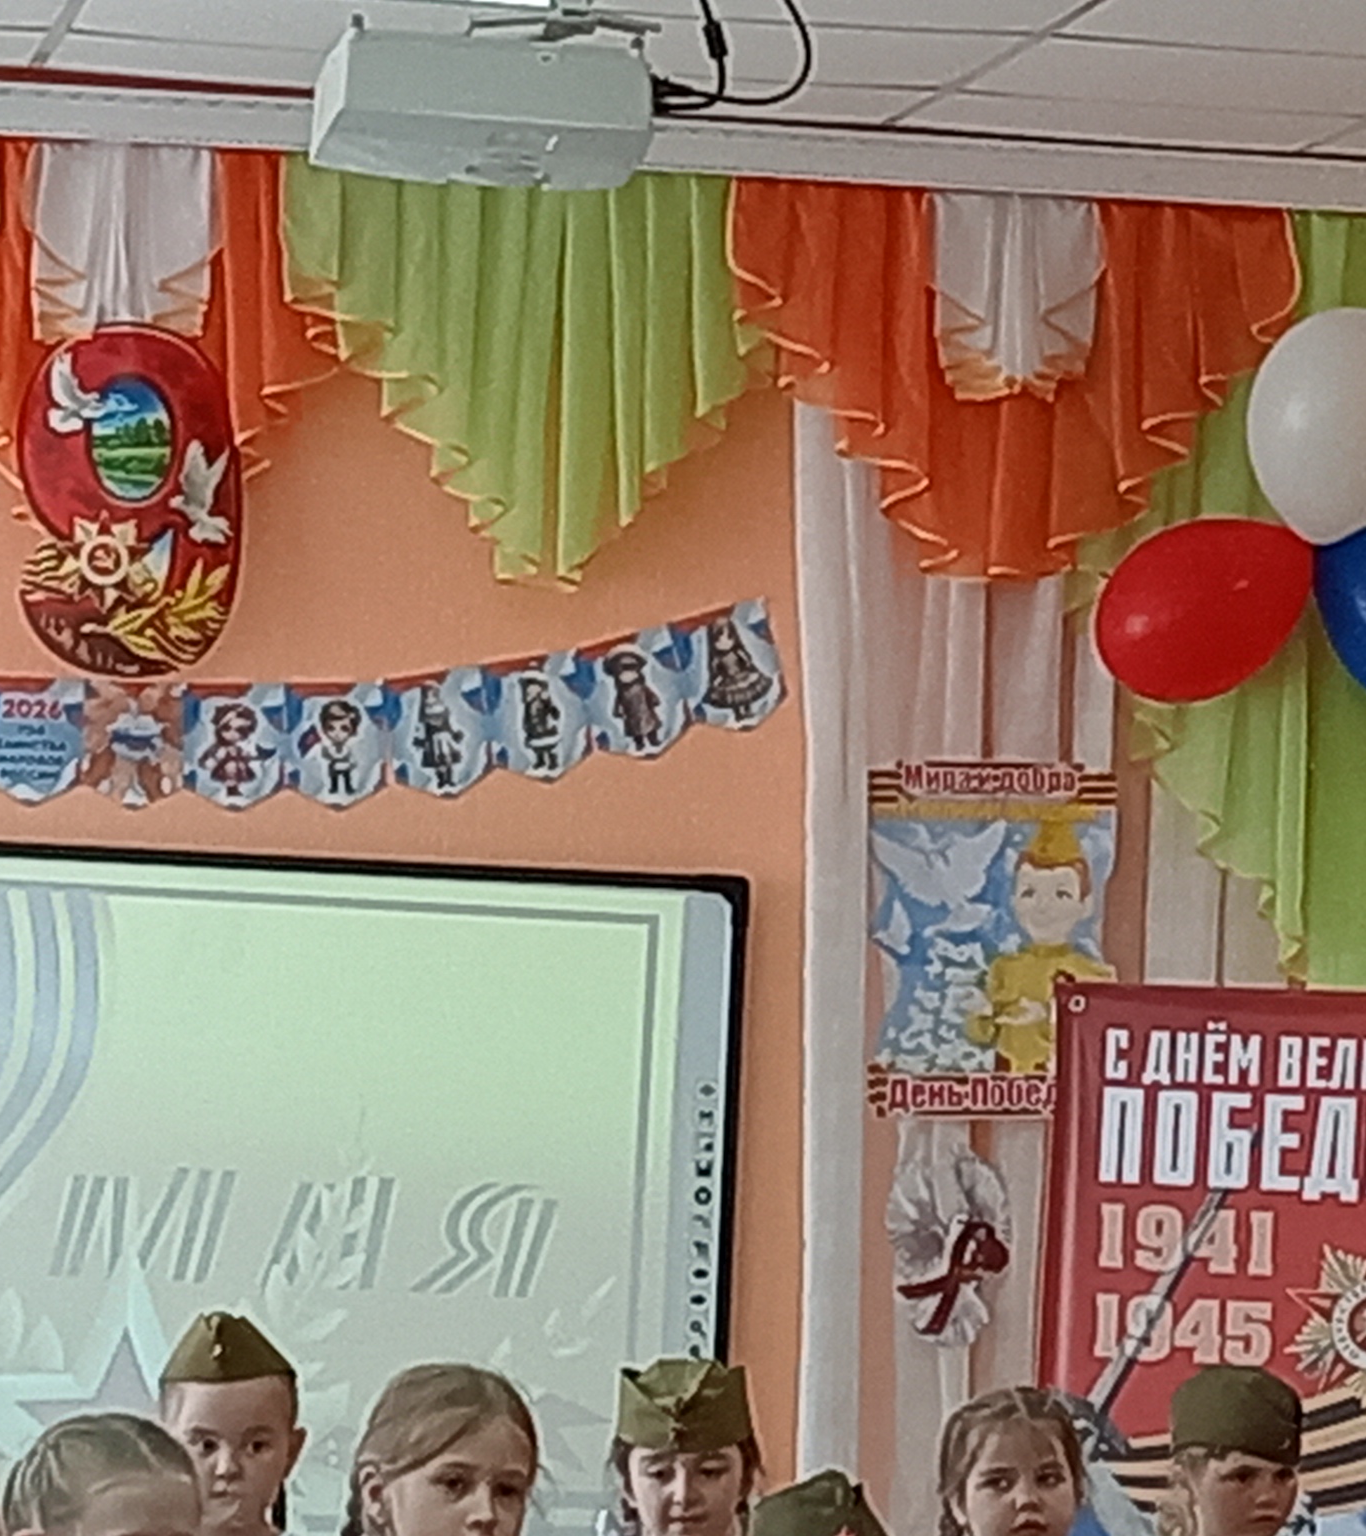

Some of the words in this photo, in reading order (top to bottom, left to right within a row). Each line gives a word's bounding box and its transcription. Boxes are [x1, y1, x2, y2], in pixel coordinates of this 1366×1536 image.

[2, 698, 63, 720] 2026
[904, 764, 970, 793] Мира
[1001, 771, 1076, 794] добра
[1105, 1028, 1129, 1080] С
[1141, 1021, 1262, 1086] ДНЁМ
[888, 1078, 965, 1112] День
[1098, 1202, 1274, 1276] 1941
[1093, 1292, 1273, 1366] 1945
